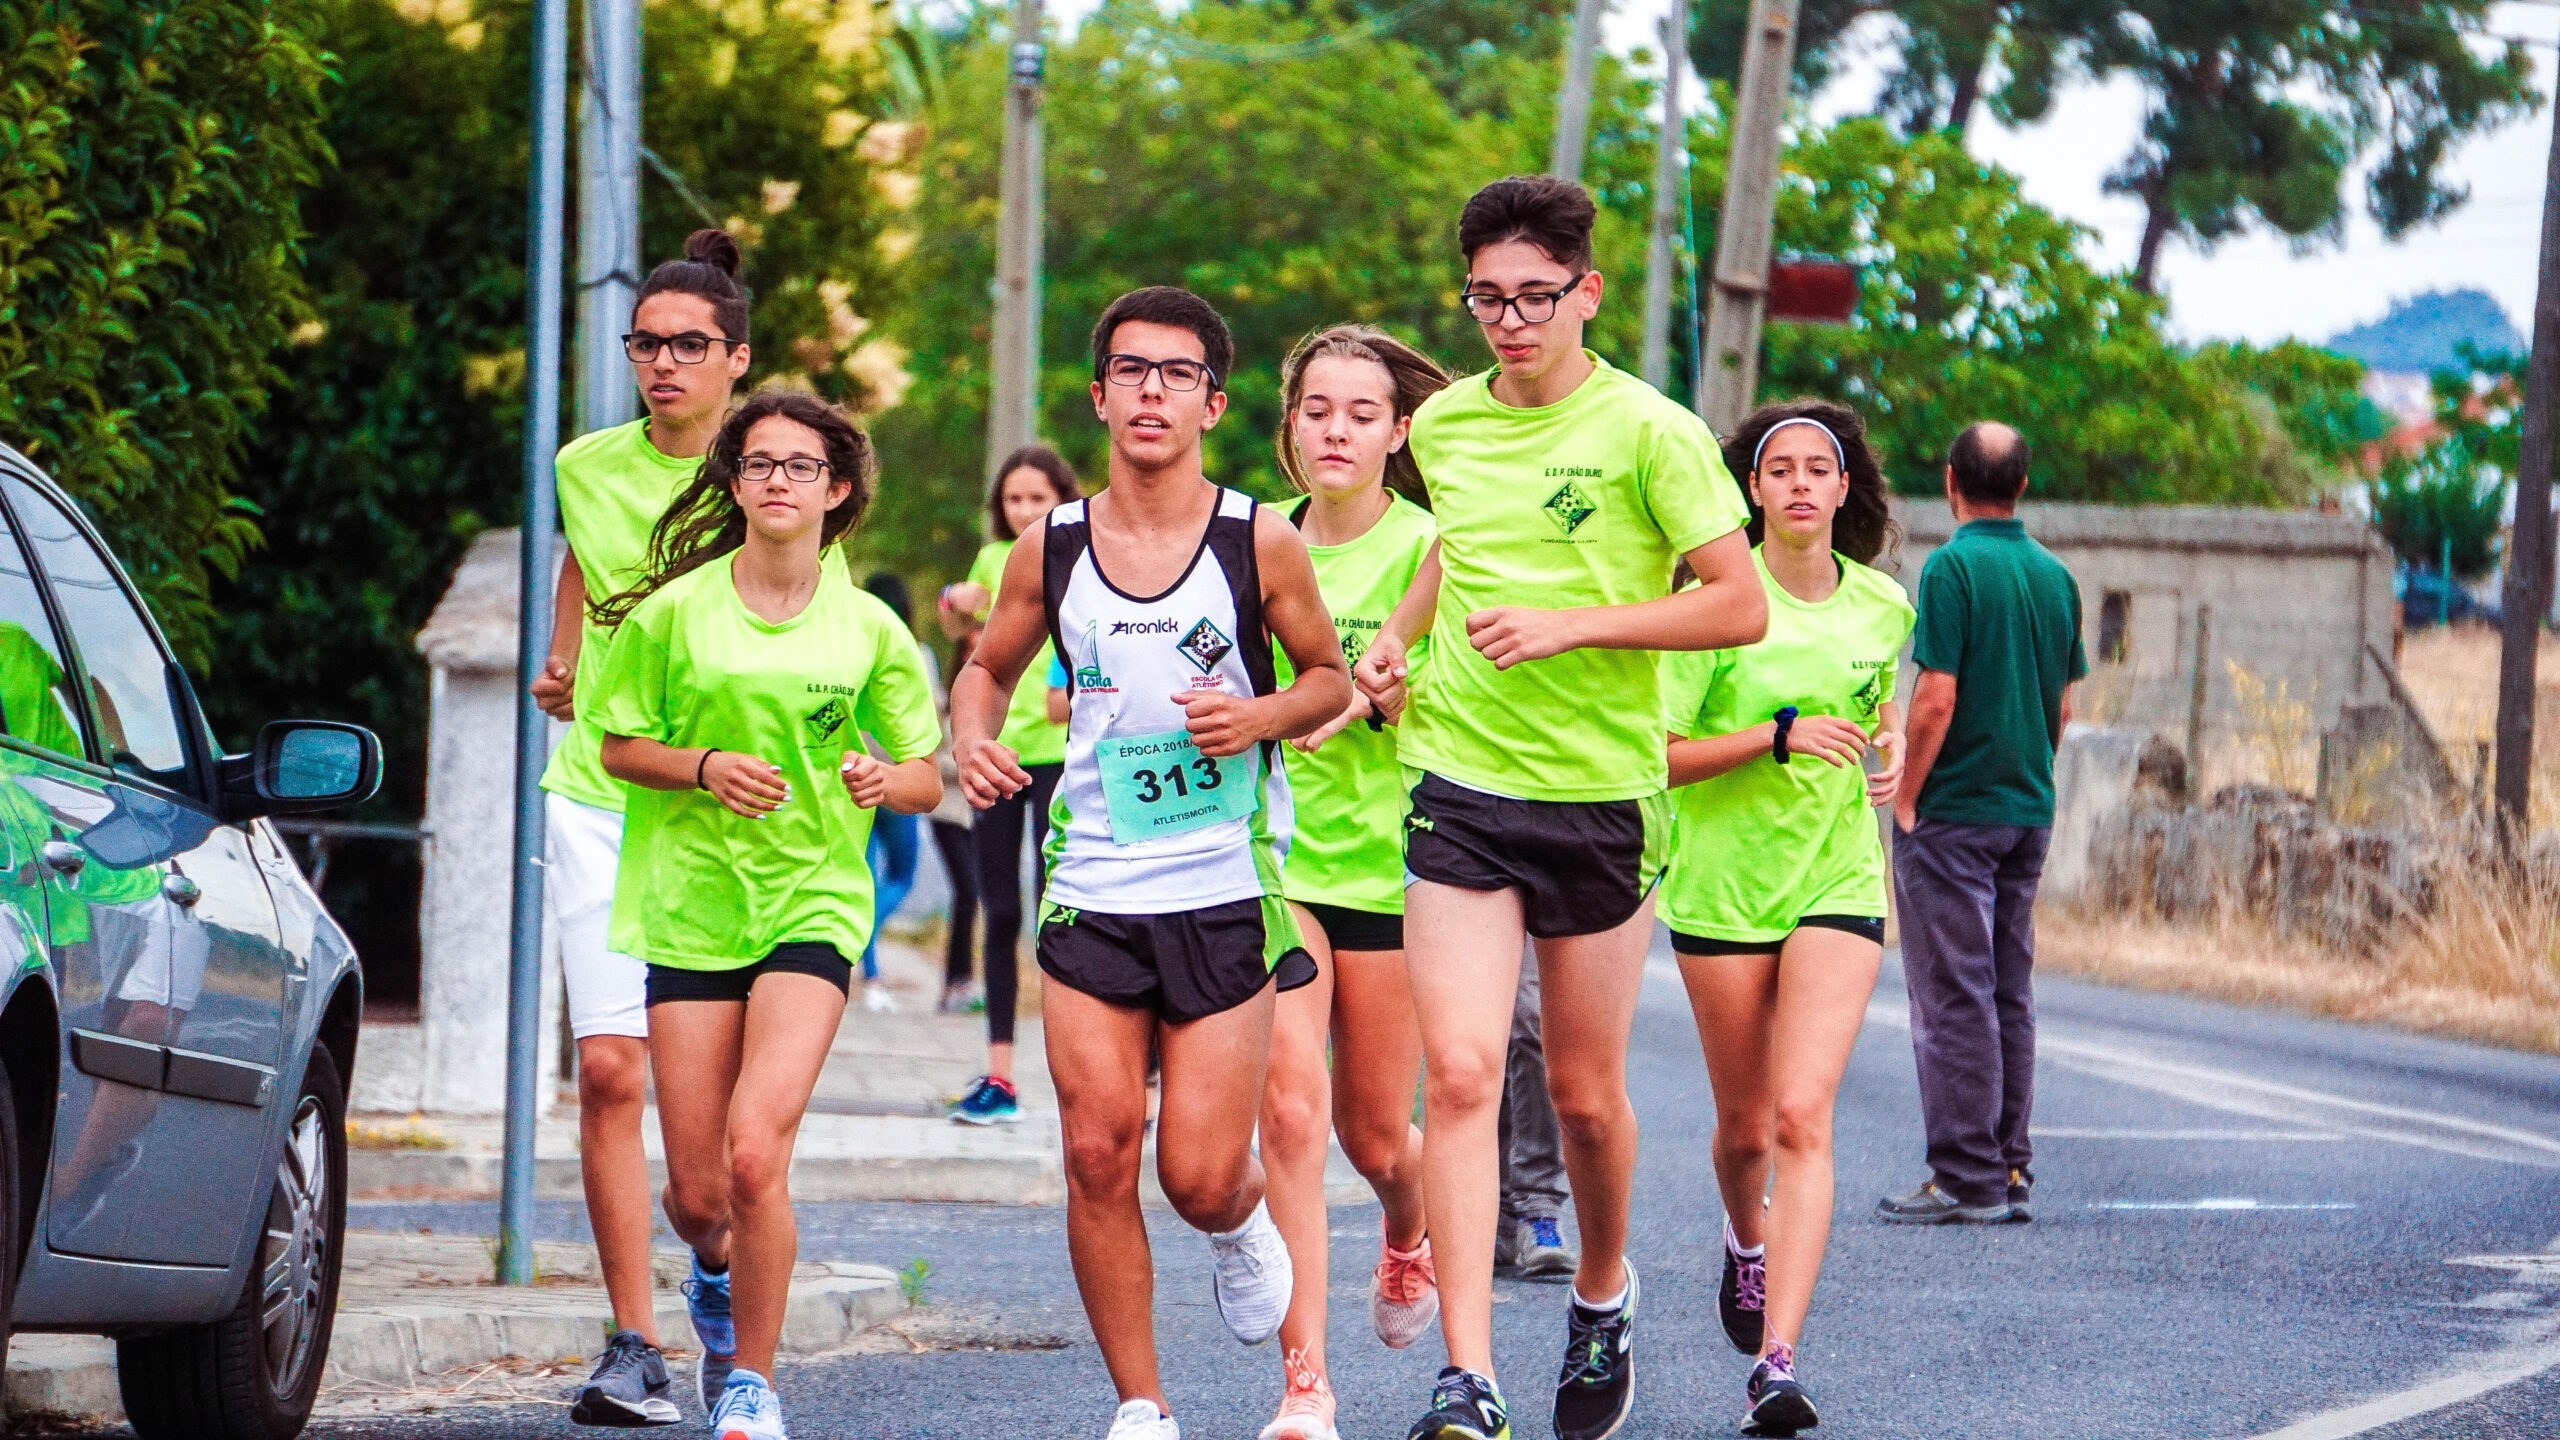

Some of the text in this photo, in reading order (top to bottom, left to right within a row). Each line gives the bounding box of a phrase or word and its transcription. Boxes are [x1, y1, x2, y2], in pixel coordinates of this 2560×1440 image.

[1119, 744, 1161, 758] ÉPOCA
[1132, 757, 1222, 803] 313
[1153, 804, 1220, 826] ATLETISMOITA
